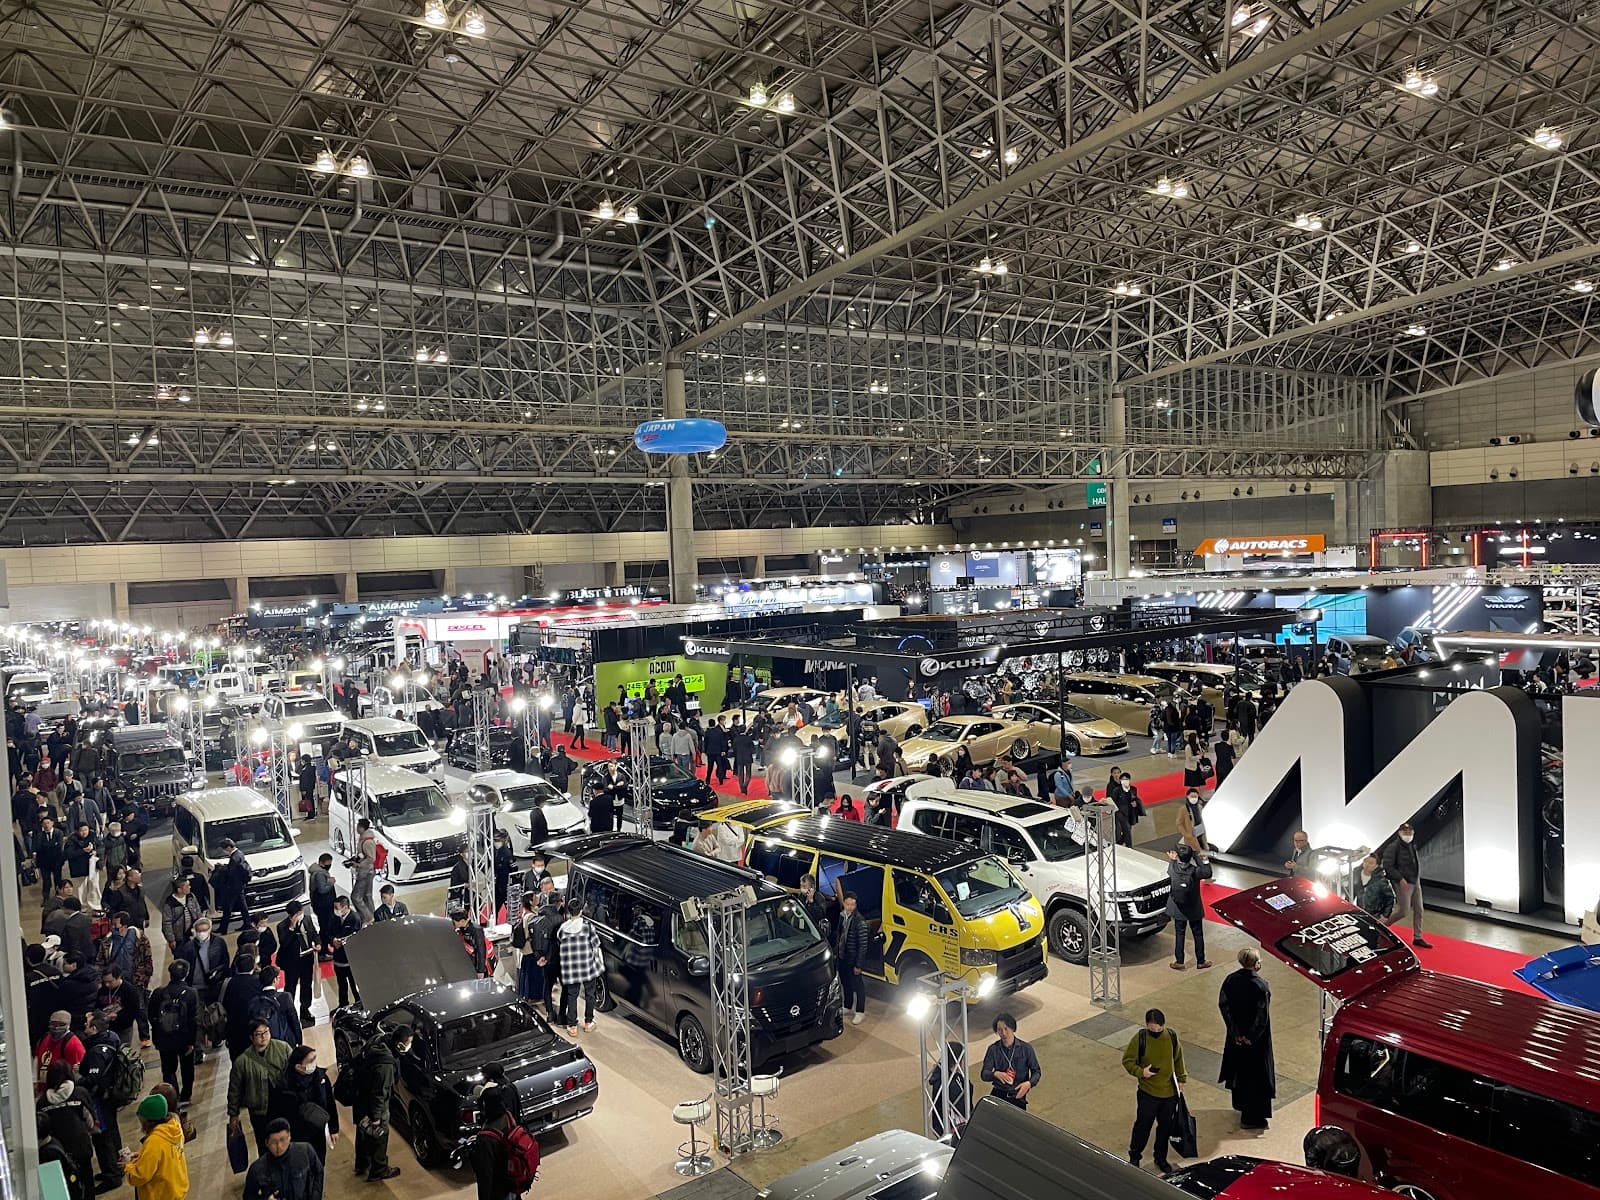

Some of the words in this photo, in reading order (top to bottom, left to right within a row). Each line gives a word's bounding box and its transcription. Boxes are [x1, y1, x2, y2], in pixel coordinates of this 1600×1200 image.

[643, 423, 675, 433] JAPAN
[1230, 540, 1308, 550] AUTOBACS
[569, 587, 601, 599] BLAST
[614, 584, 644, 597] TRAIL
[696, 645, 730, 655] KUHL
[649, 660, 676, 675] ACOAT
[941, 656, 998, 671] KUHL
[929, 923, 958, 937] CRS
